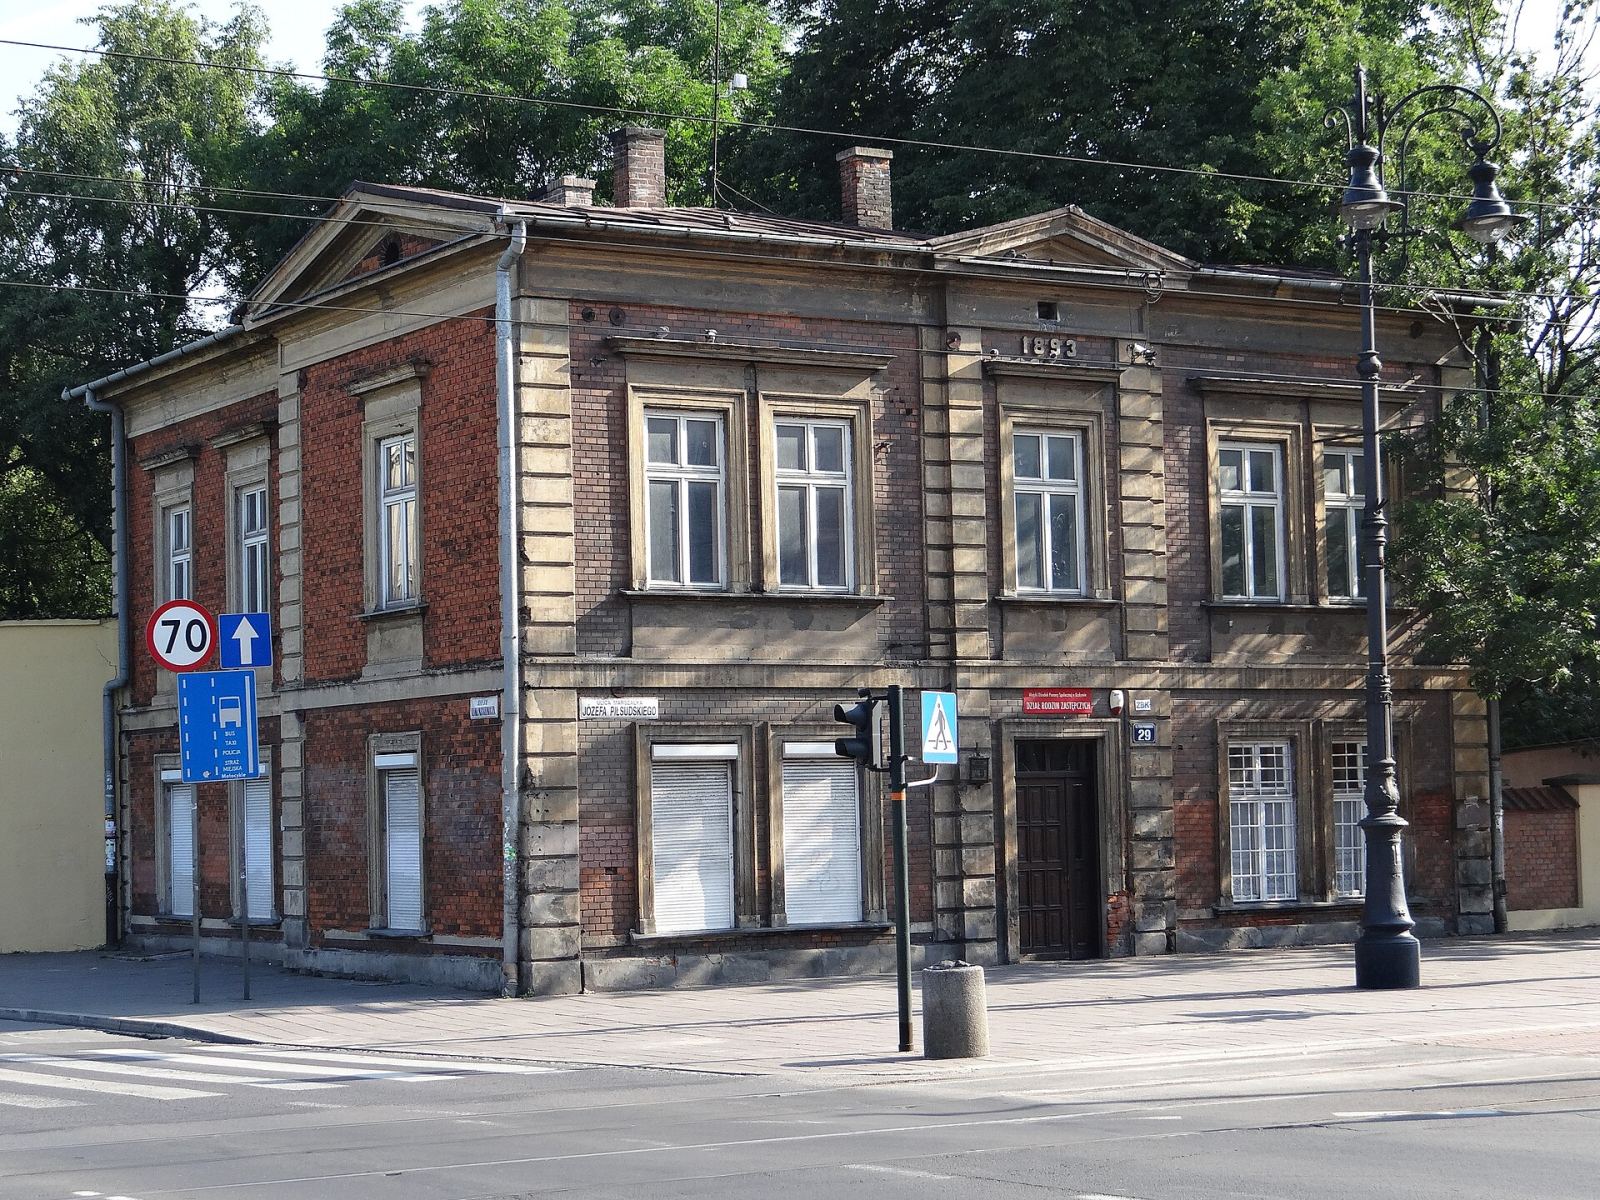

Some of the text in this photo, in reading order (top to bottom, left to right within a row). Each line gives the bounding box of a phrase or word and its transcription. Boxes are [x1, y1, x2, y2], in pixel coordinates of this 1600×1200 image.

[1023, 336, 1077, 358] 1893
[161, 619, 207, 654] 70
[583, 704, 657, 716] JÓZEFA PIŁSUDSKIEGO
[1136, 701, 1150, 709] ZBK
[1138, 729, 1151, 741] 29
